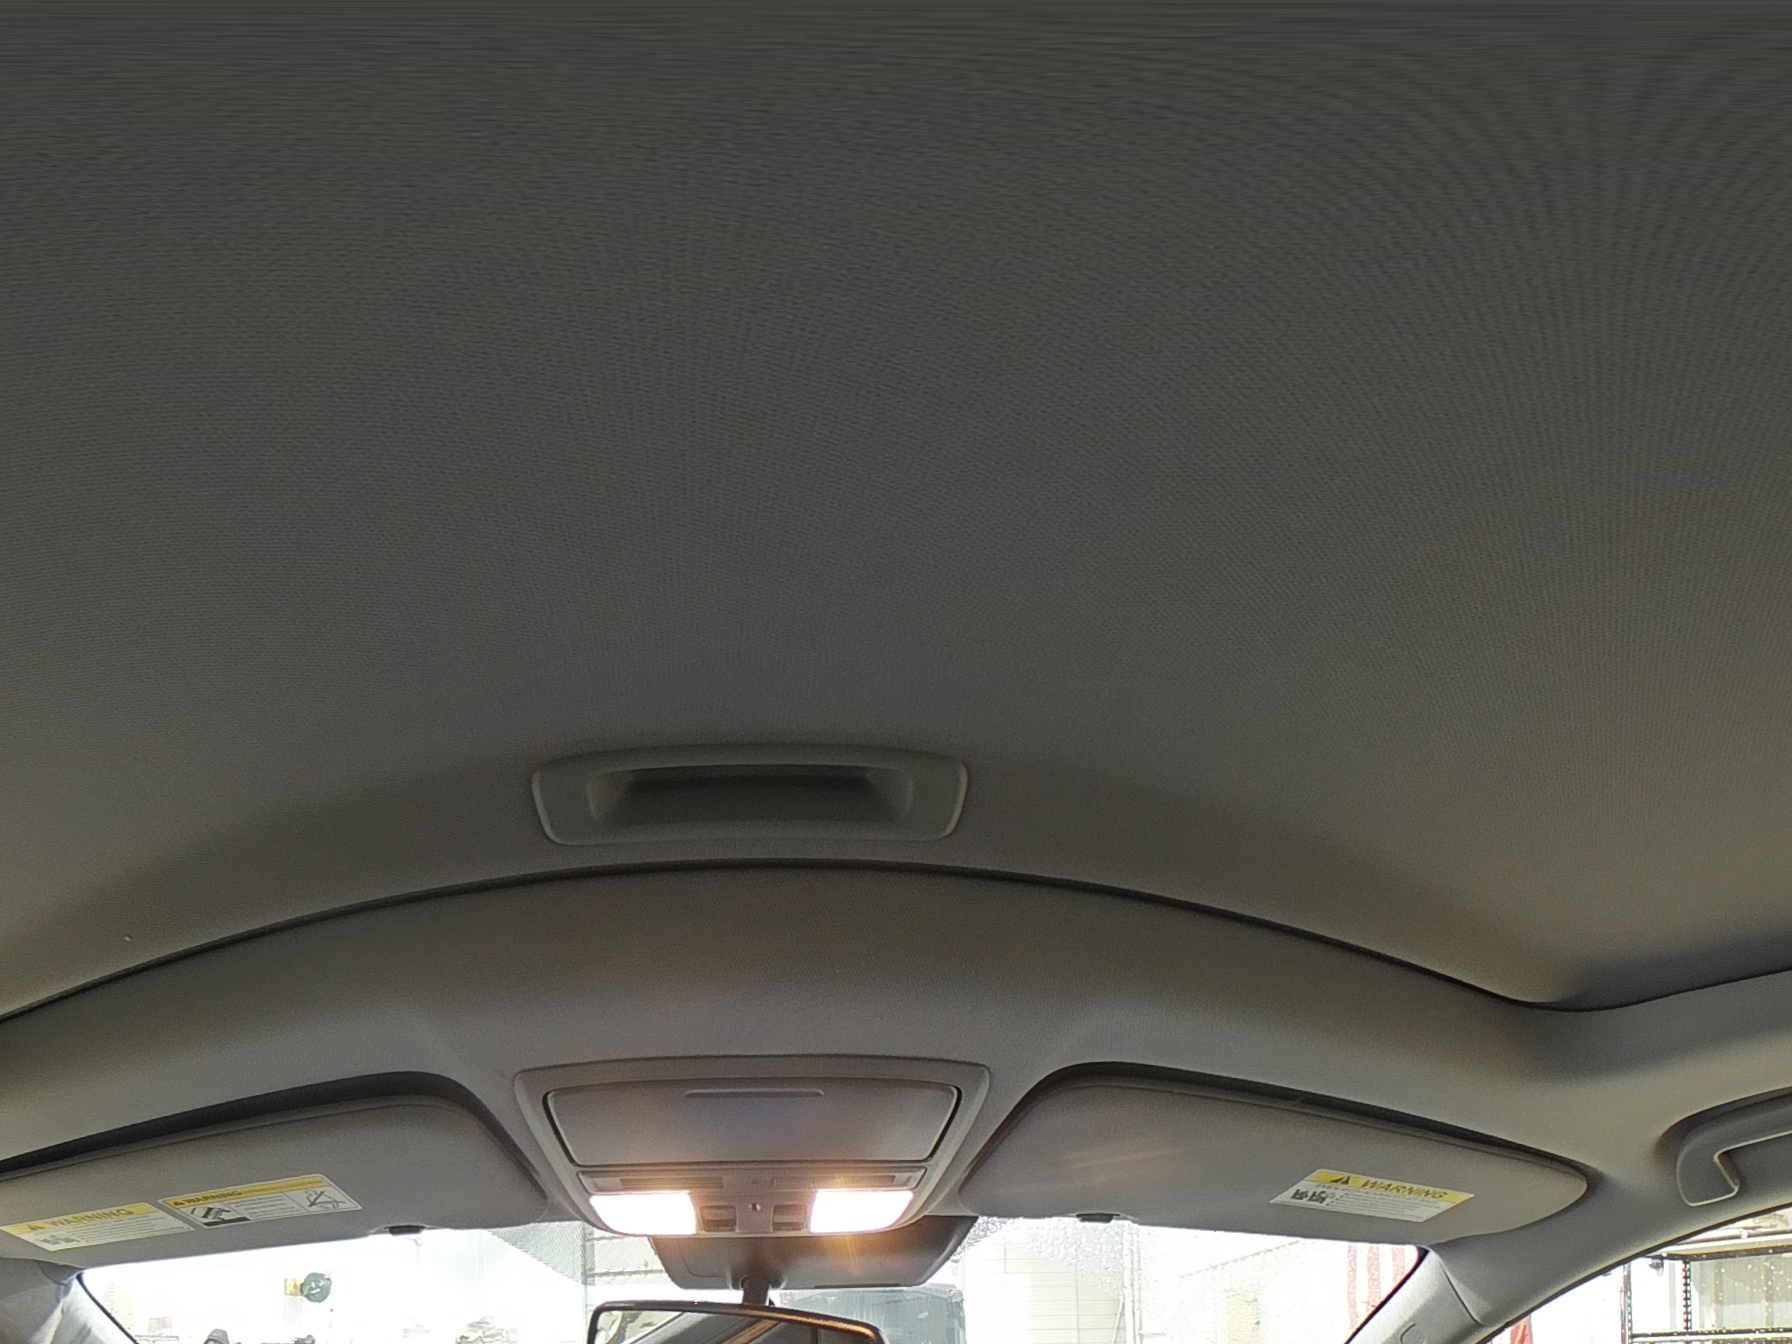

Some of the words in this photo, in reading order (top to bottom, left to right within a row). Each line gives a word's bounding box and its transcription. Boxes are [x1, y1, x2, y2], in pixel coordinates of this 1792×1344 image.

[183, 1190, 243, 1204] WARNING
[1361, 1179, 1449, 1199] WARNING
[49, 1208, 134, 1228] WARNING
